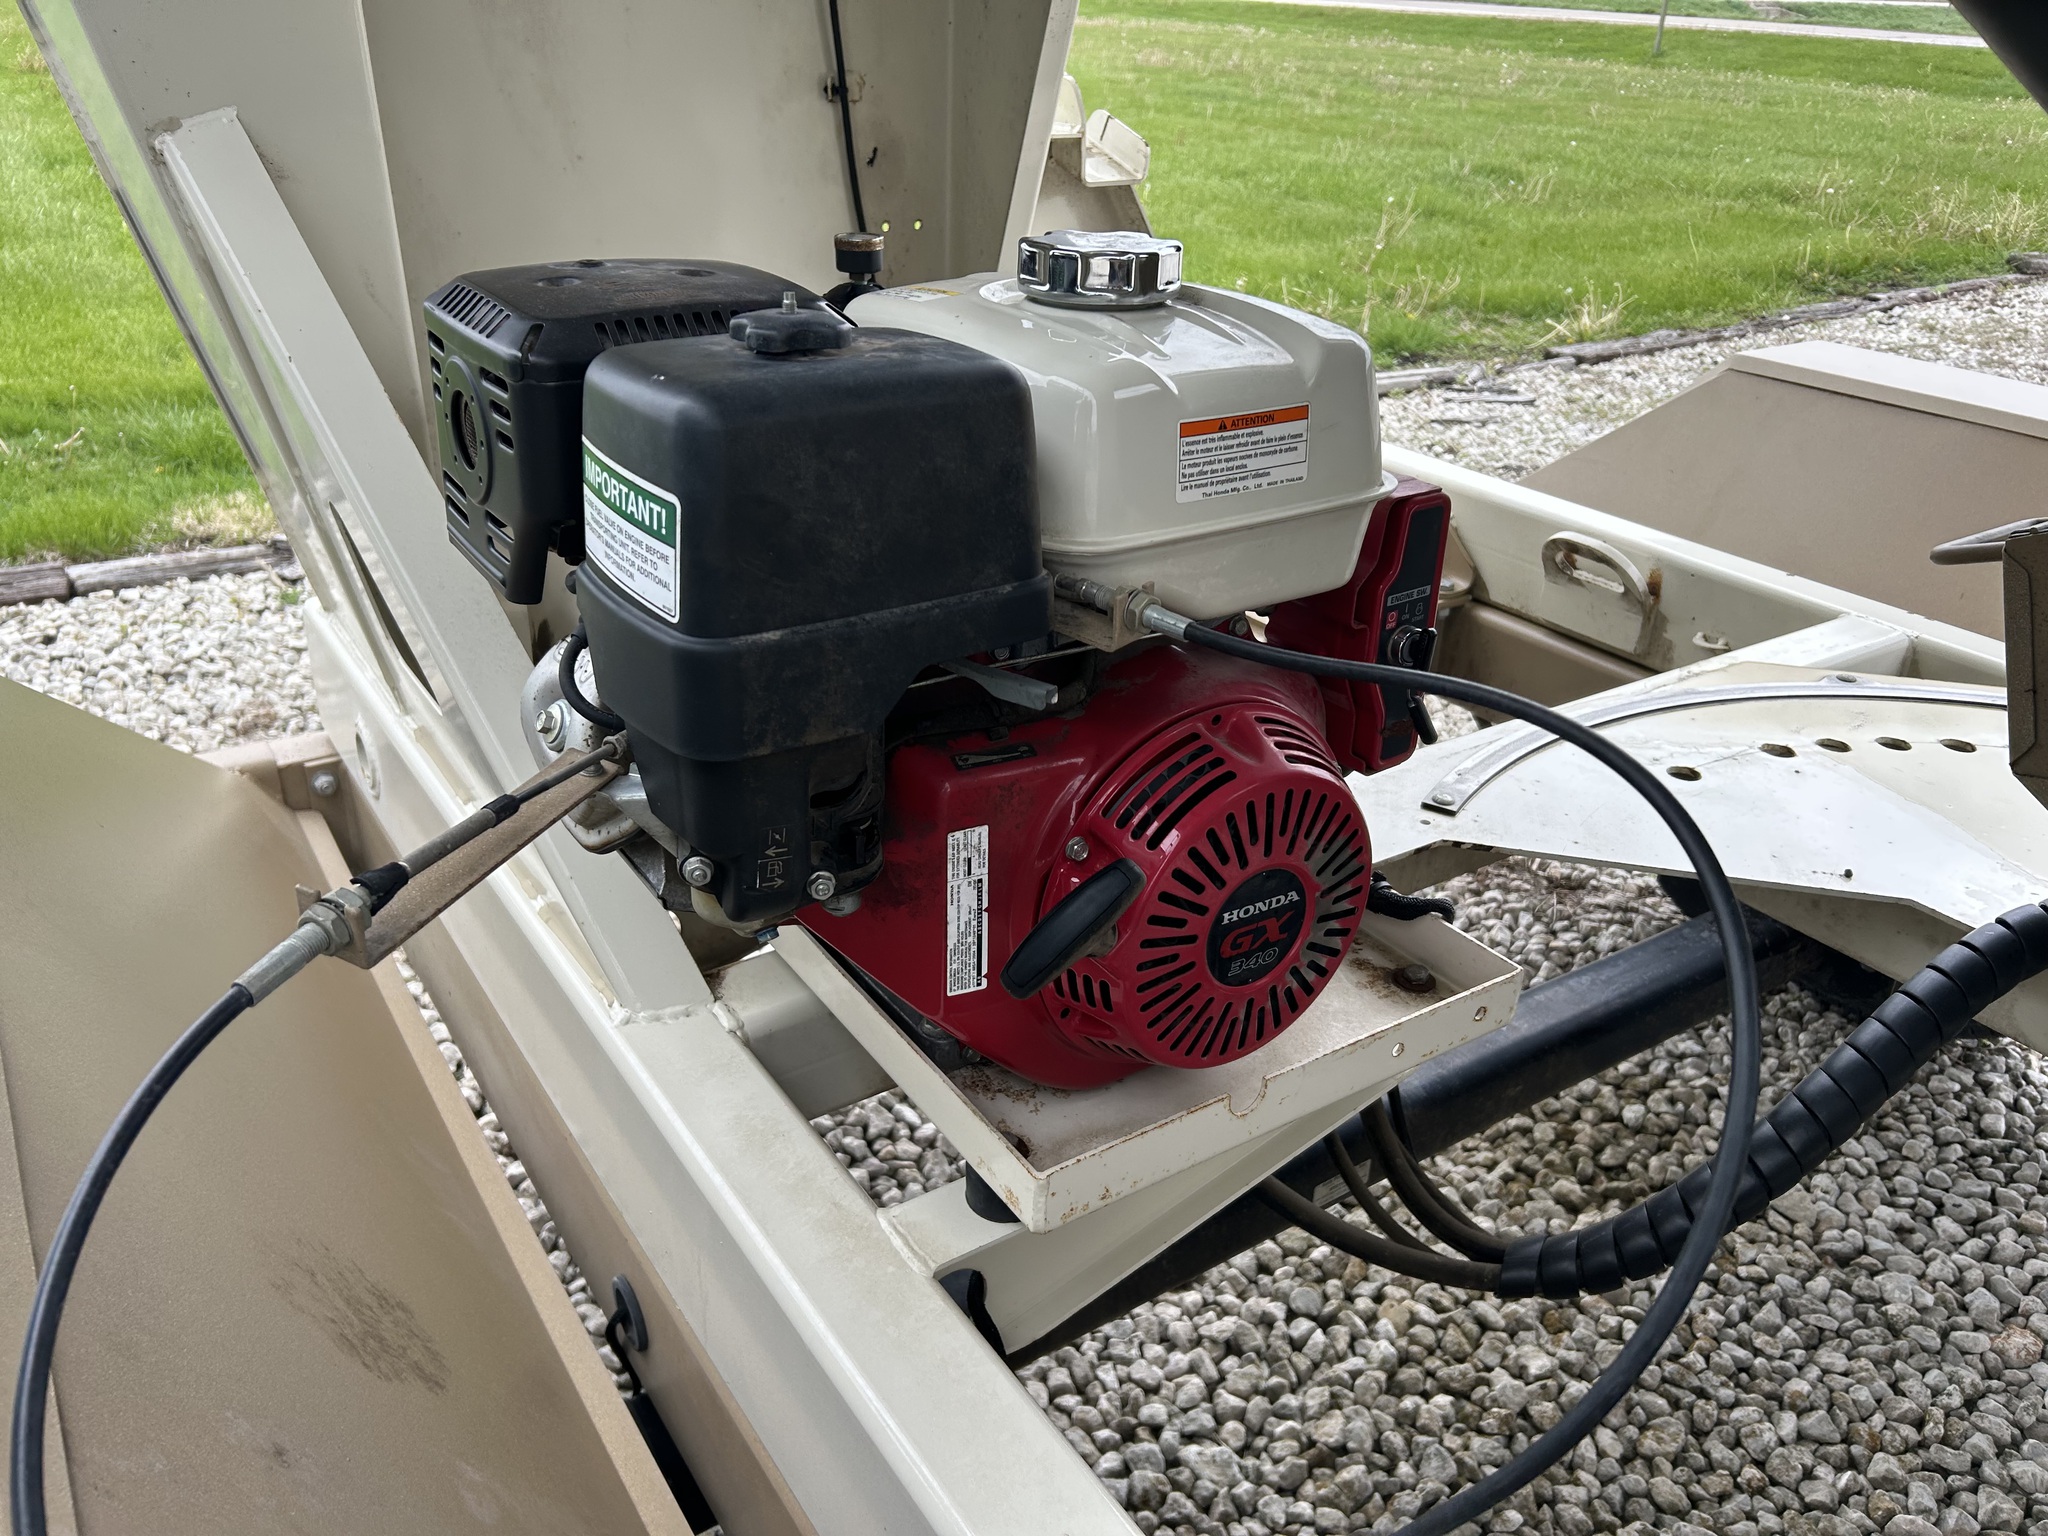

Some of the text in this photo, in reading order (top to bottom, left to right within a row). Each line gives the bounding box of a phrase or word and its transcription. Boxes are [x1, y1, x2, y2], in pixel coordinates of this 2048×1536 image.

[1231, 414, 1274, 428] ATTENTION
[1217, 432, 1240, 441] inflammable
[1236, 440, 1250, 448] refroidir
[1278, 435, 1286, 443] plein
[1202, 458, 1216, 467] produit
[1259, 448, 1278, 456] monoxyde
[1196, 469, 1209, 477] utiliser
[1215, 477, 1238, 486] propriétaire
[1239, 474, 1249, 482] avant
[584, 454, 666, 535] IMPORTANT!
[590, 512, 617, 544] TRANSPORTING
[631, 547, 648, 565] REFER
[650, 560, 658, 571] TO
[604, 514, 616, 531] VALVE
[617, 524, 623, 536] ON
[624, 530, 644, 550] ENGINE
[645, 544, 670, 565] BEFORE
[604, 551, 636, 582] INFORMATION.
[605, 539, 625, 561] MANUALS
[626, 555, 636, 570] FOR
[637, 564, 672, 592] ADDITIONAL
[1390, 587, 1429, 604] ENGINE SW.
[1386, 622, 1396, 630] OFF
[1412, 614, 1424, 622] START
[1222, 890, 1300, 925] HONDA
[1220, 910, 1295, 958] GX
[1228, 947, 1278, 976] 340
